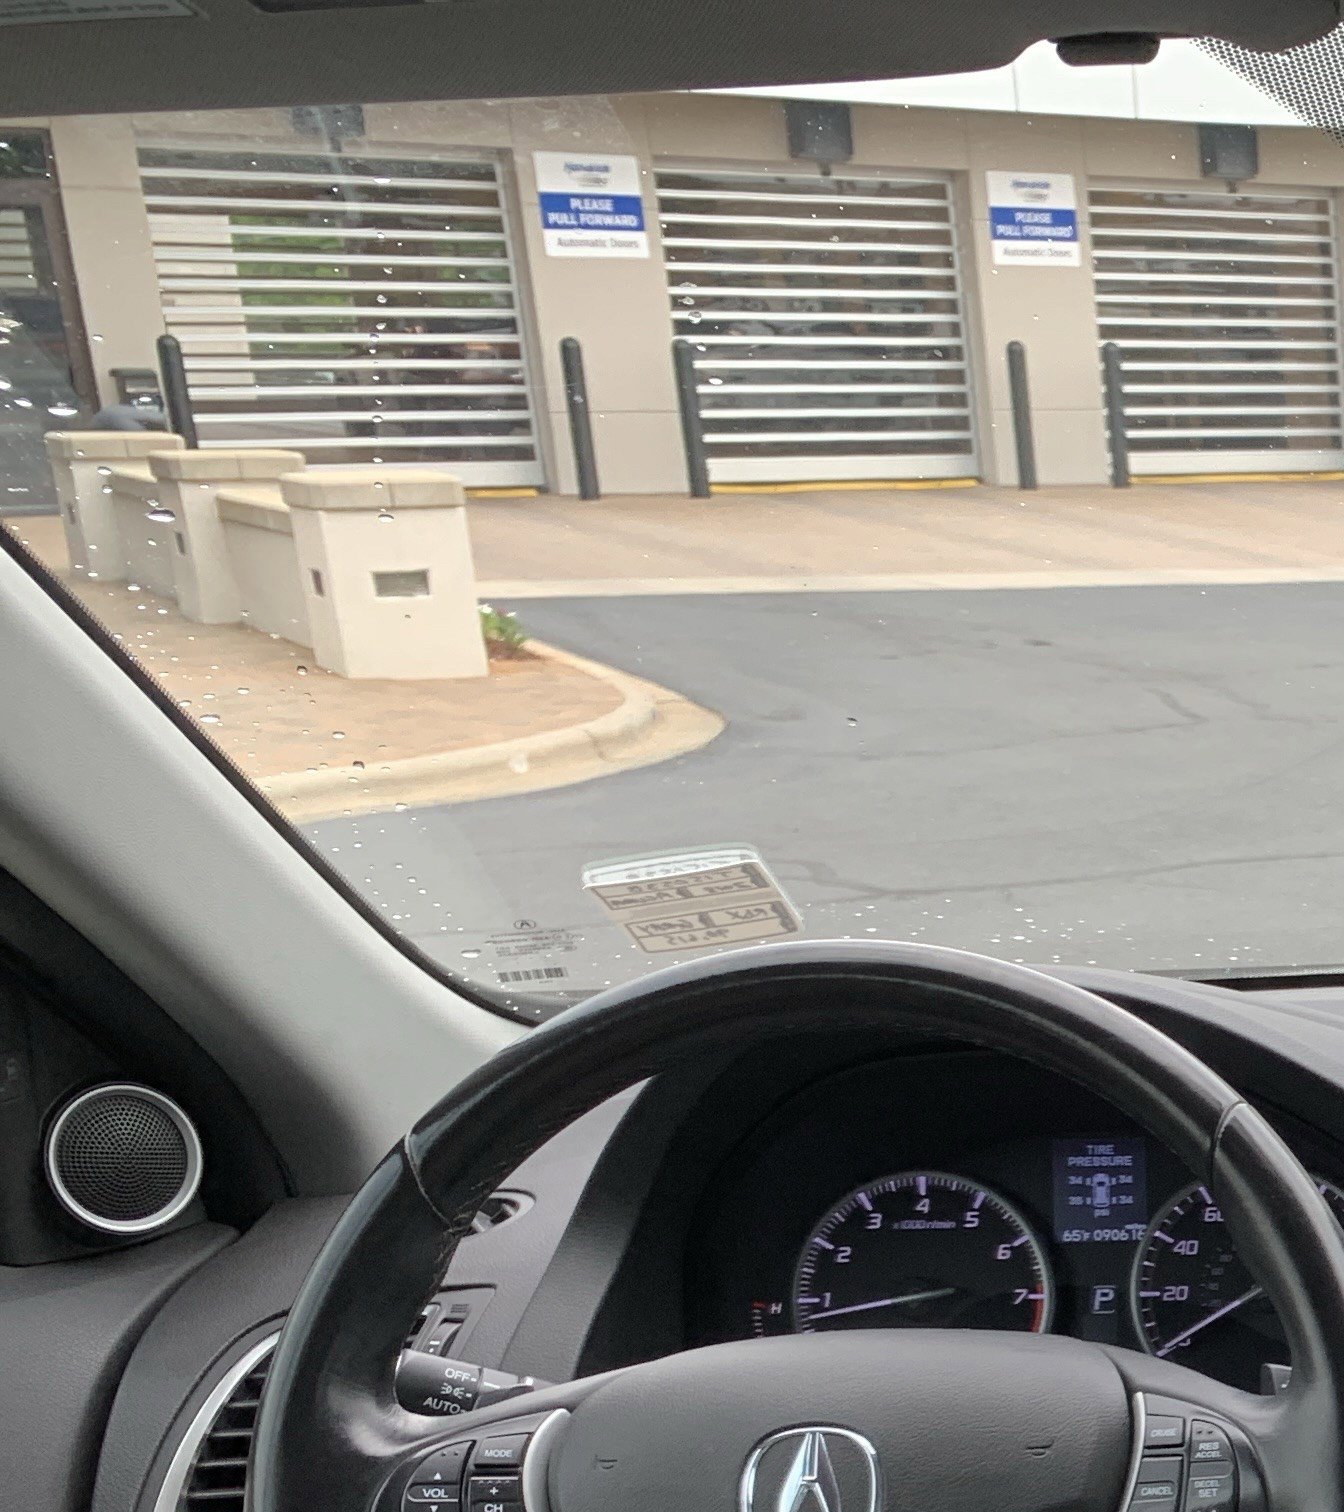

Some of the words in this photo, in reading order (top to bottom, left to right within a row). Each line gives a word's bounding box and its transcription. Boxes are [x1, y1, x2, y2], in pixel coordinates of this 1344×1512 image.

[569, 197, 614, 212] PLEASE
[547, 211, 579, 226] PULL
[579, 212, 639, 229] FORWARD
[1014, 211, 1053, 224] PLEASE
[995, 224, 1022, 237] PULL
[1022, 225, 1074, 239] FORWARD
[1086, 1144, 1115, 1155] TIRE
[1068, 1155, 1133, 1167] PRESSURE
[915, 1198, 930, 1214] 4
[865, 1212, 883, 1230] 3
[963, 1211, 980, 1228] 5
[836, 1247, 852, 1263] 2
[996, 1250, 1012, 1260] 6
[1174, 1240, 1199, 1255] 40
[821, 1292, 832, 1308] 1
[1012, 1288, 1030, 1306] 7
[1093, 1288, 1115, 1311] P
[1162, 1286, 1189, 1301] 20
[771, 1302, 783, 1314] H
[444, 1367, 471, 1382] OFF
[422, 1397, 461, 1415] AUTO
[484, 1450, 513, 1458] MODE
[1199, 1442, 1220, 1451] RES
[1195, 1451, 1222, 1459] ACCEL
[1140, 1486, 1173, 1496] CANCEL
[1194, 1480, 1220, 1488] DECEL
[422, 1488, 449, 1498] VOL
[1199, 1488, 1218, 1498] SET
